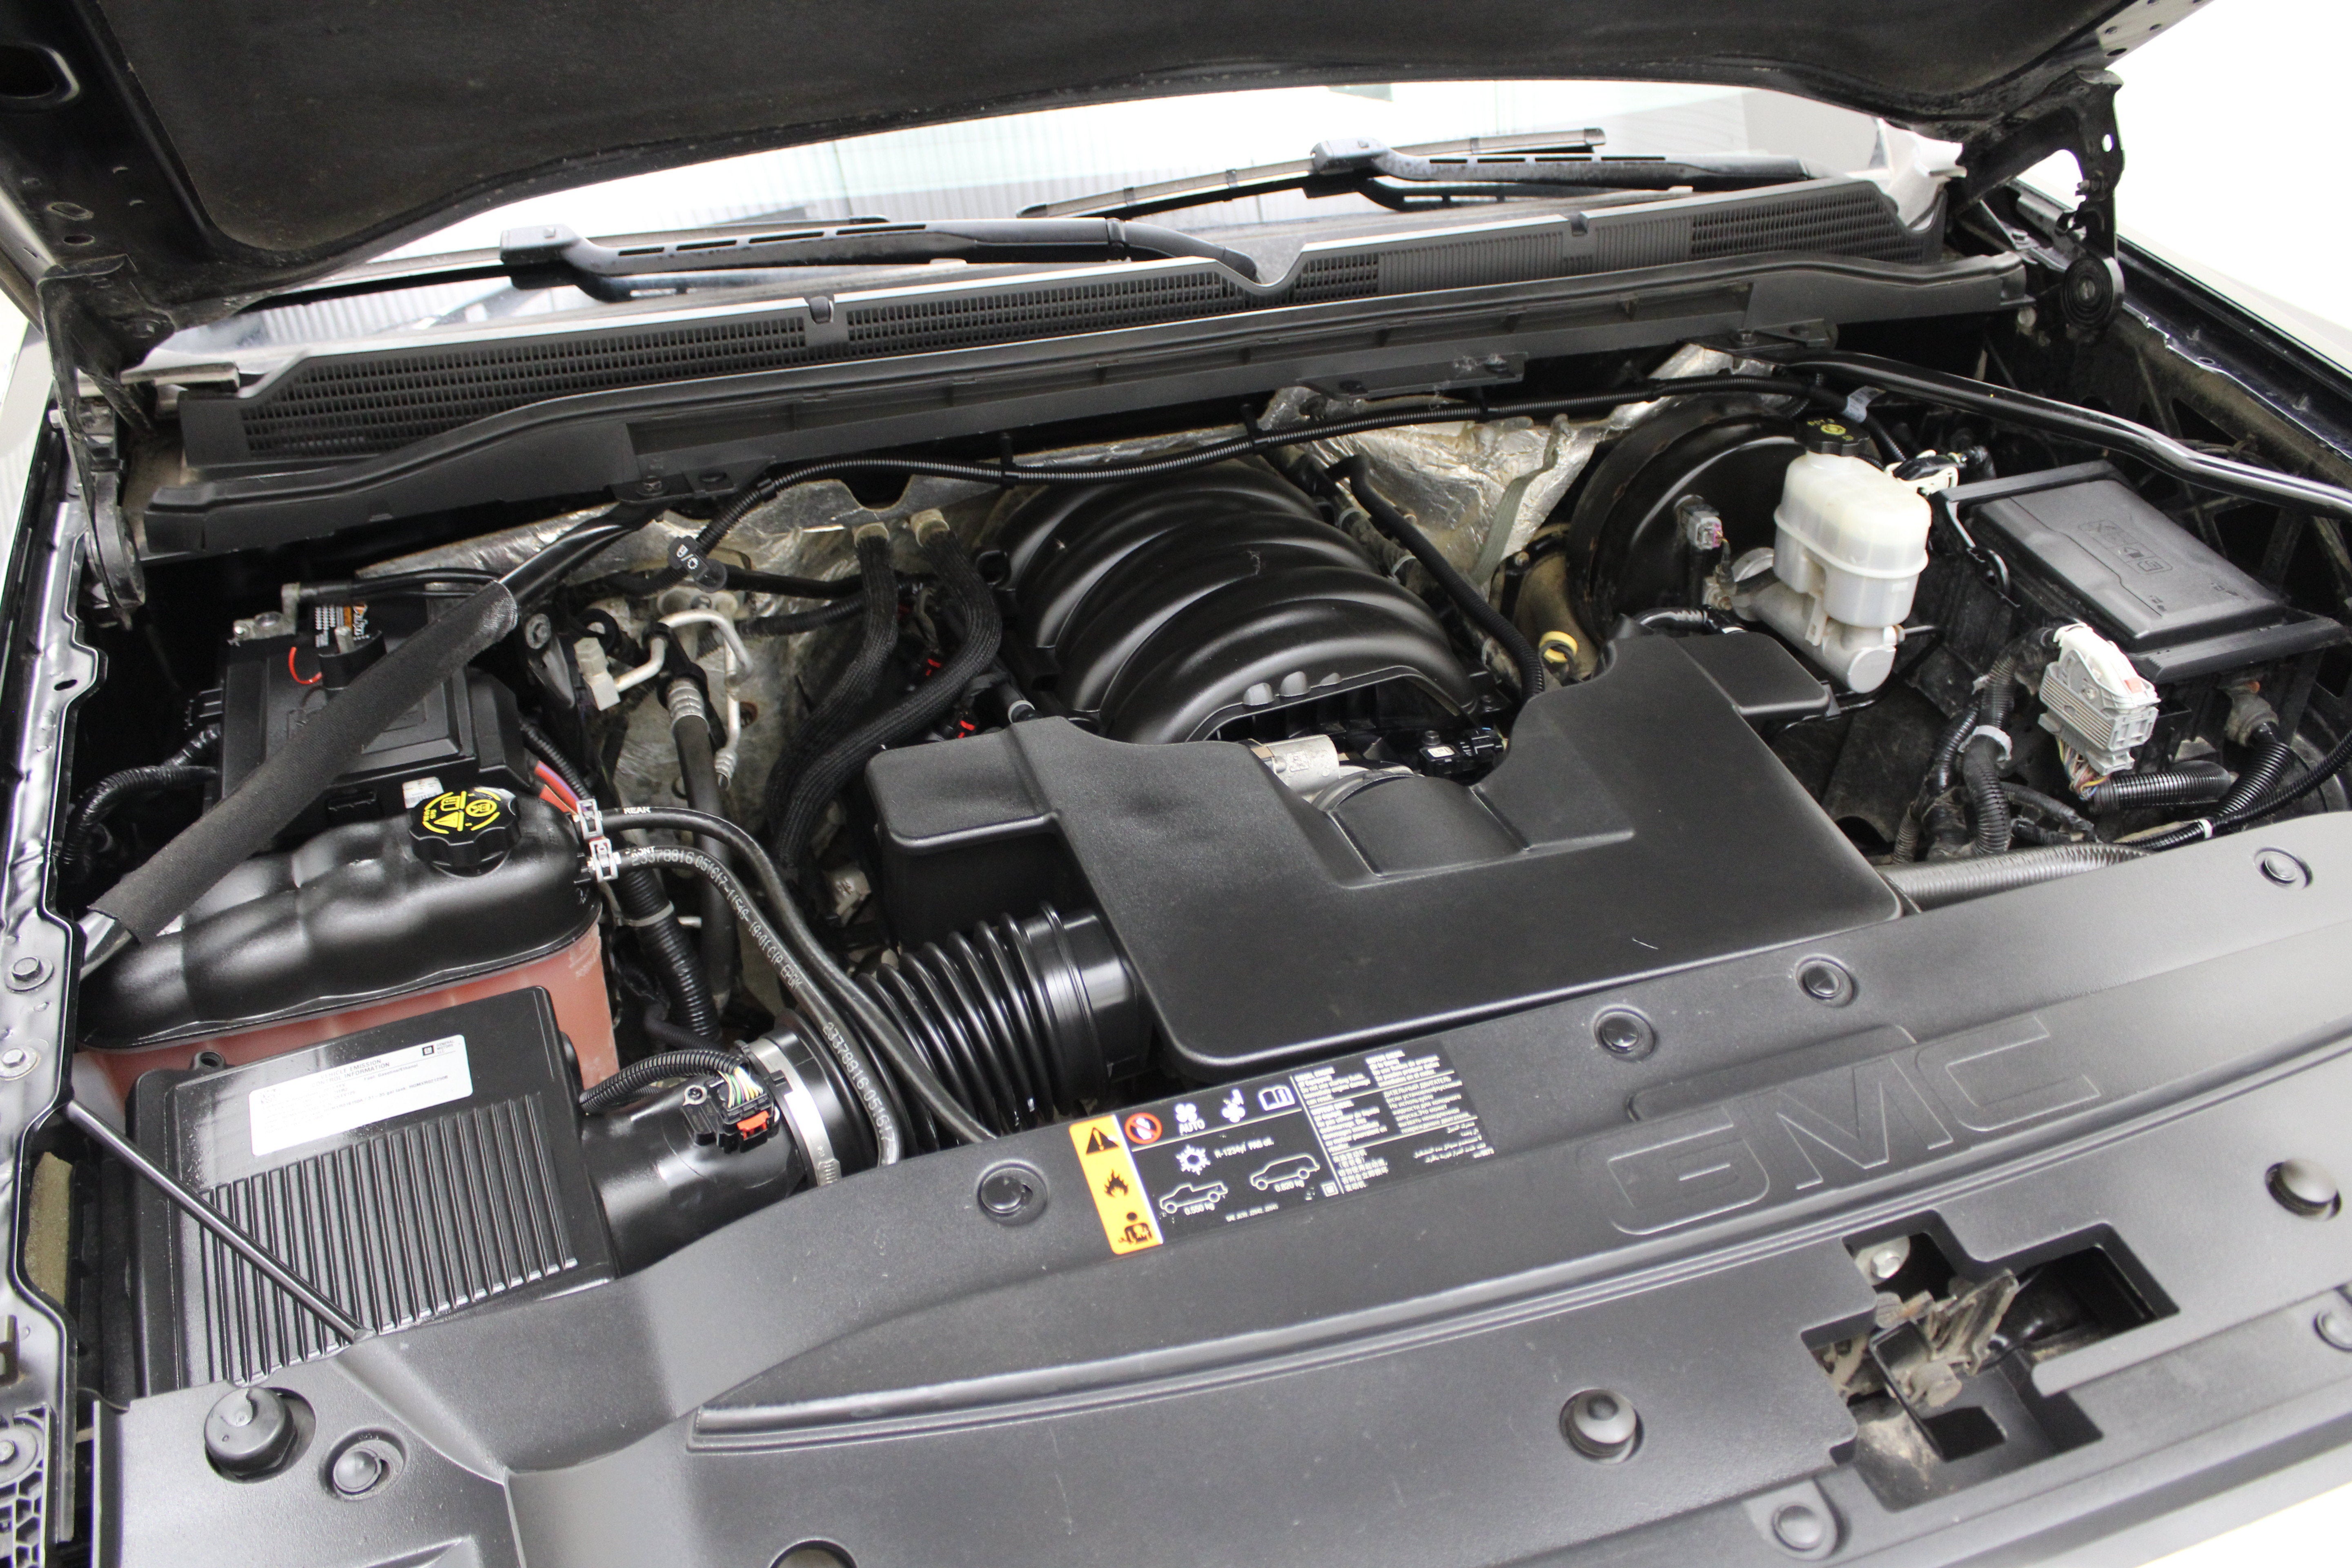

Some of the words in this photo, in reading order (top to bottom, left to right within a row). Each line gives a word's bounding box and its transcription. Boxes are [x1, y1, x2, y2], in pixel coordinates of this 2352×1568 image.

[823, 1022, 869, 1090] 23378816
[312, 1076, 341, 1087] CONTROL
[344, 1062, 390, 1078] INFORMATION
[321, 1068, 347, 1079] VEHICLE
[350, 1059, 381, 1072] EMISSION
[1179, 1118, 1205, 1135] AUTO
[1578, 1016, 2100, 1235] GMC
[1214, 1141, 1247, 1159] R-1234yf
[1274, 1181, 1294, 1193] 0.820
[1294, 1178, 1305, 1189] kg
[1184, 1204, 1205, 1216] 0.550
[1204, 1201, 1216, 1212] kg
